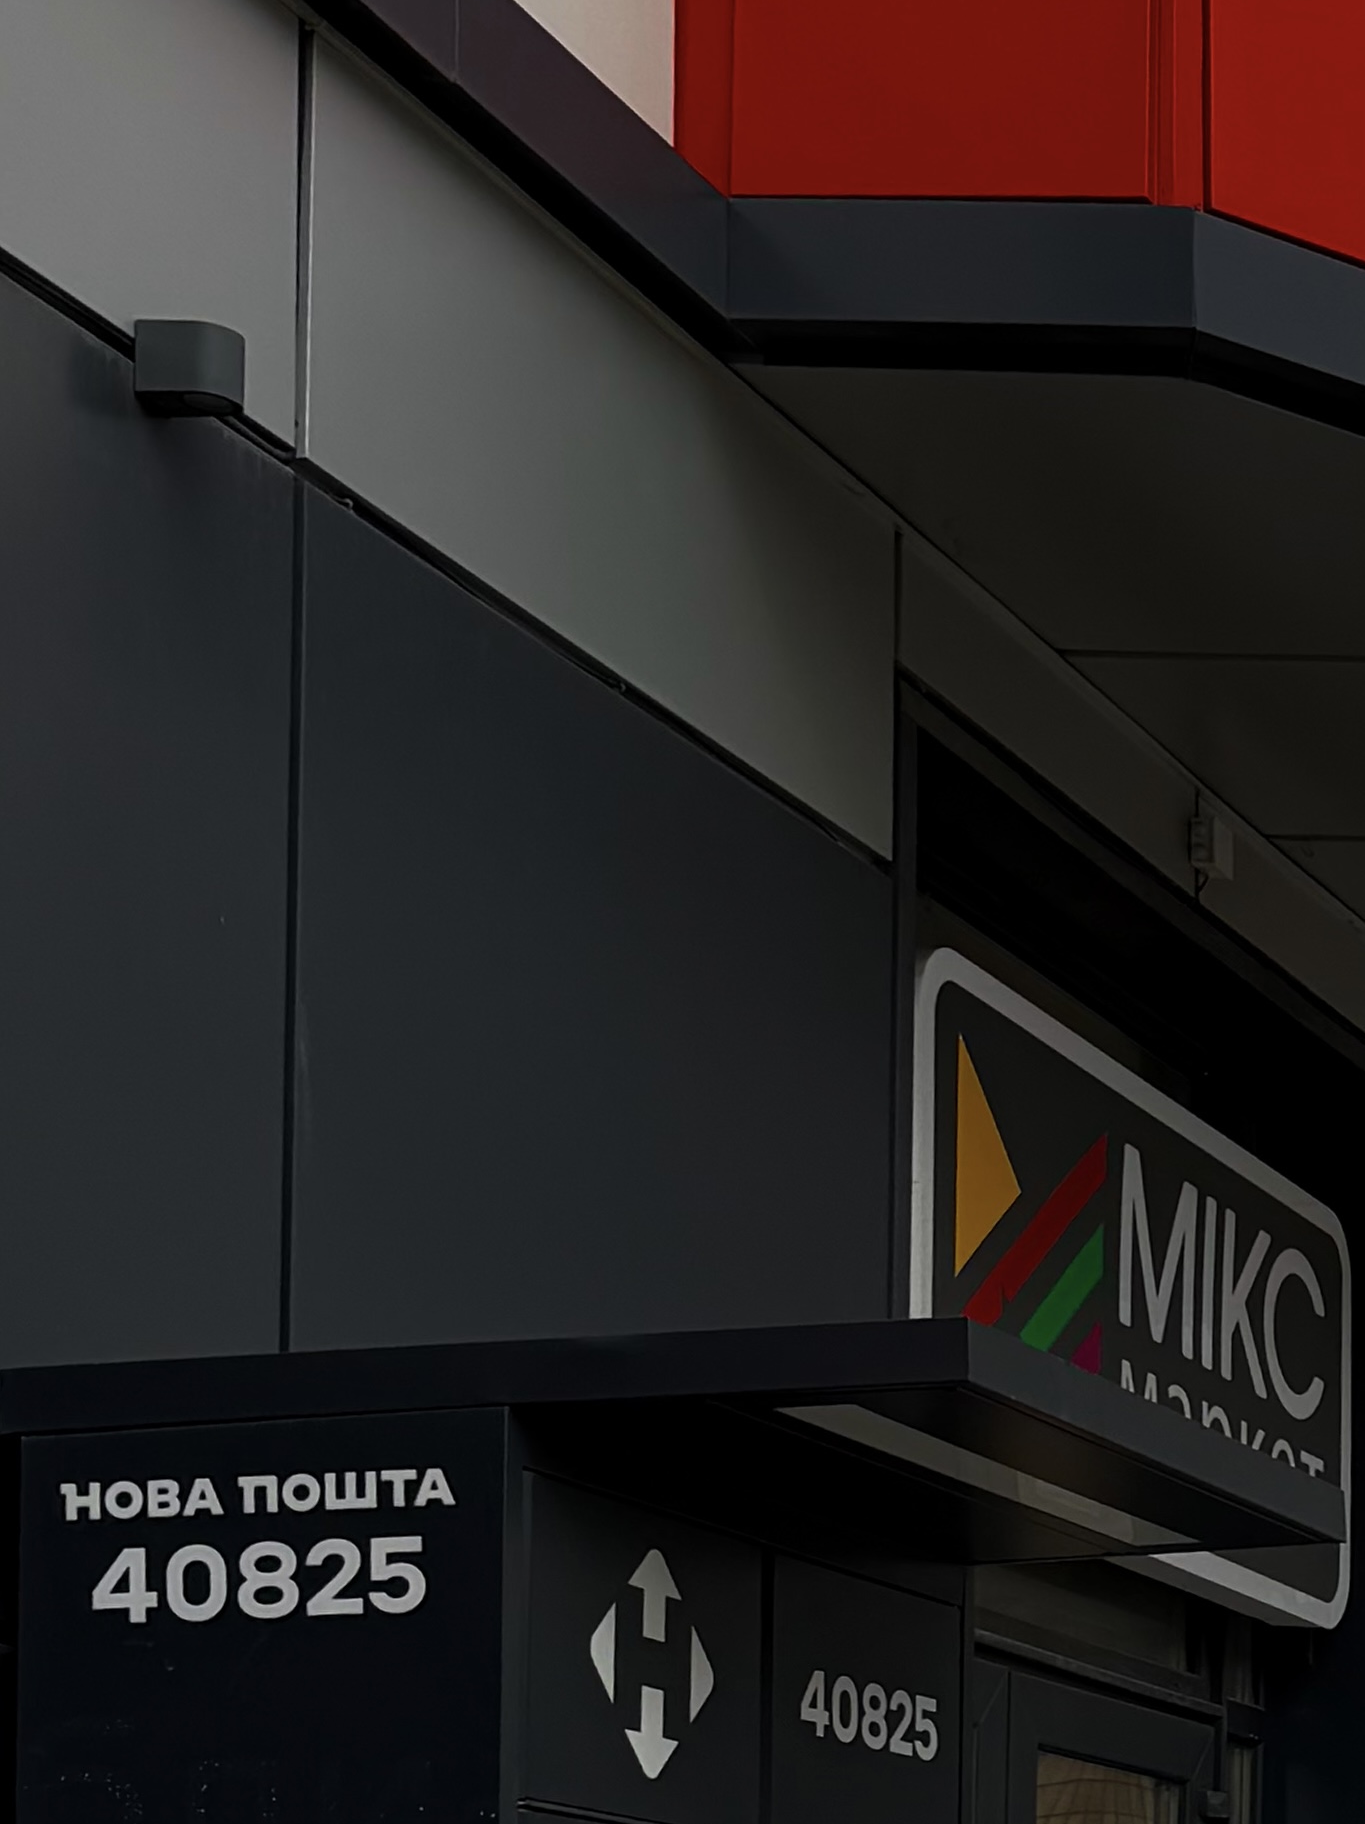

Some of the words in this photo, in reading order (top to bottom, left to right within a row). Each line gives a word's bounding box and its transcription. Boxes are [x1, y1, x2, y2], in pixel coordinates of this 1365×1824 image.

[1118, 1143, 1326, 1420] МІКС
[60, 1478, 224, 1520] НОВА
[238, 1468, 455, 1513] ПОШТА
[92, 1536, 426, 1623] 40825
[801, 1671, 937, 1760] 40825
